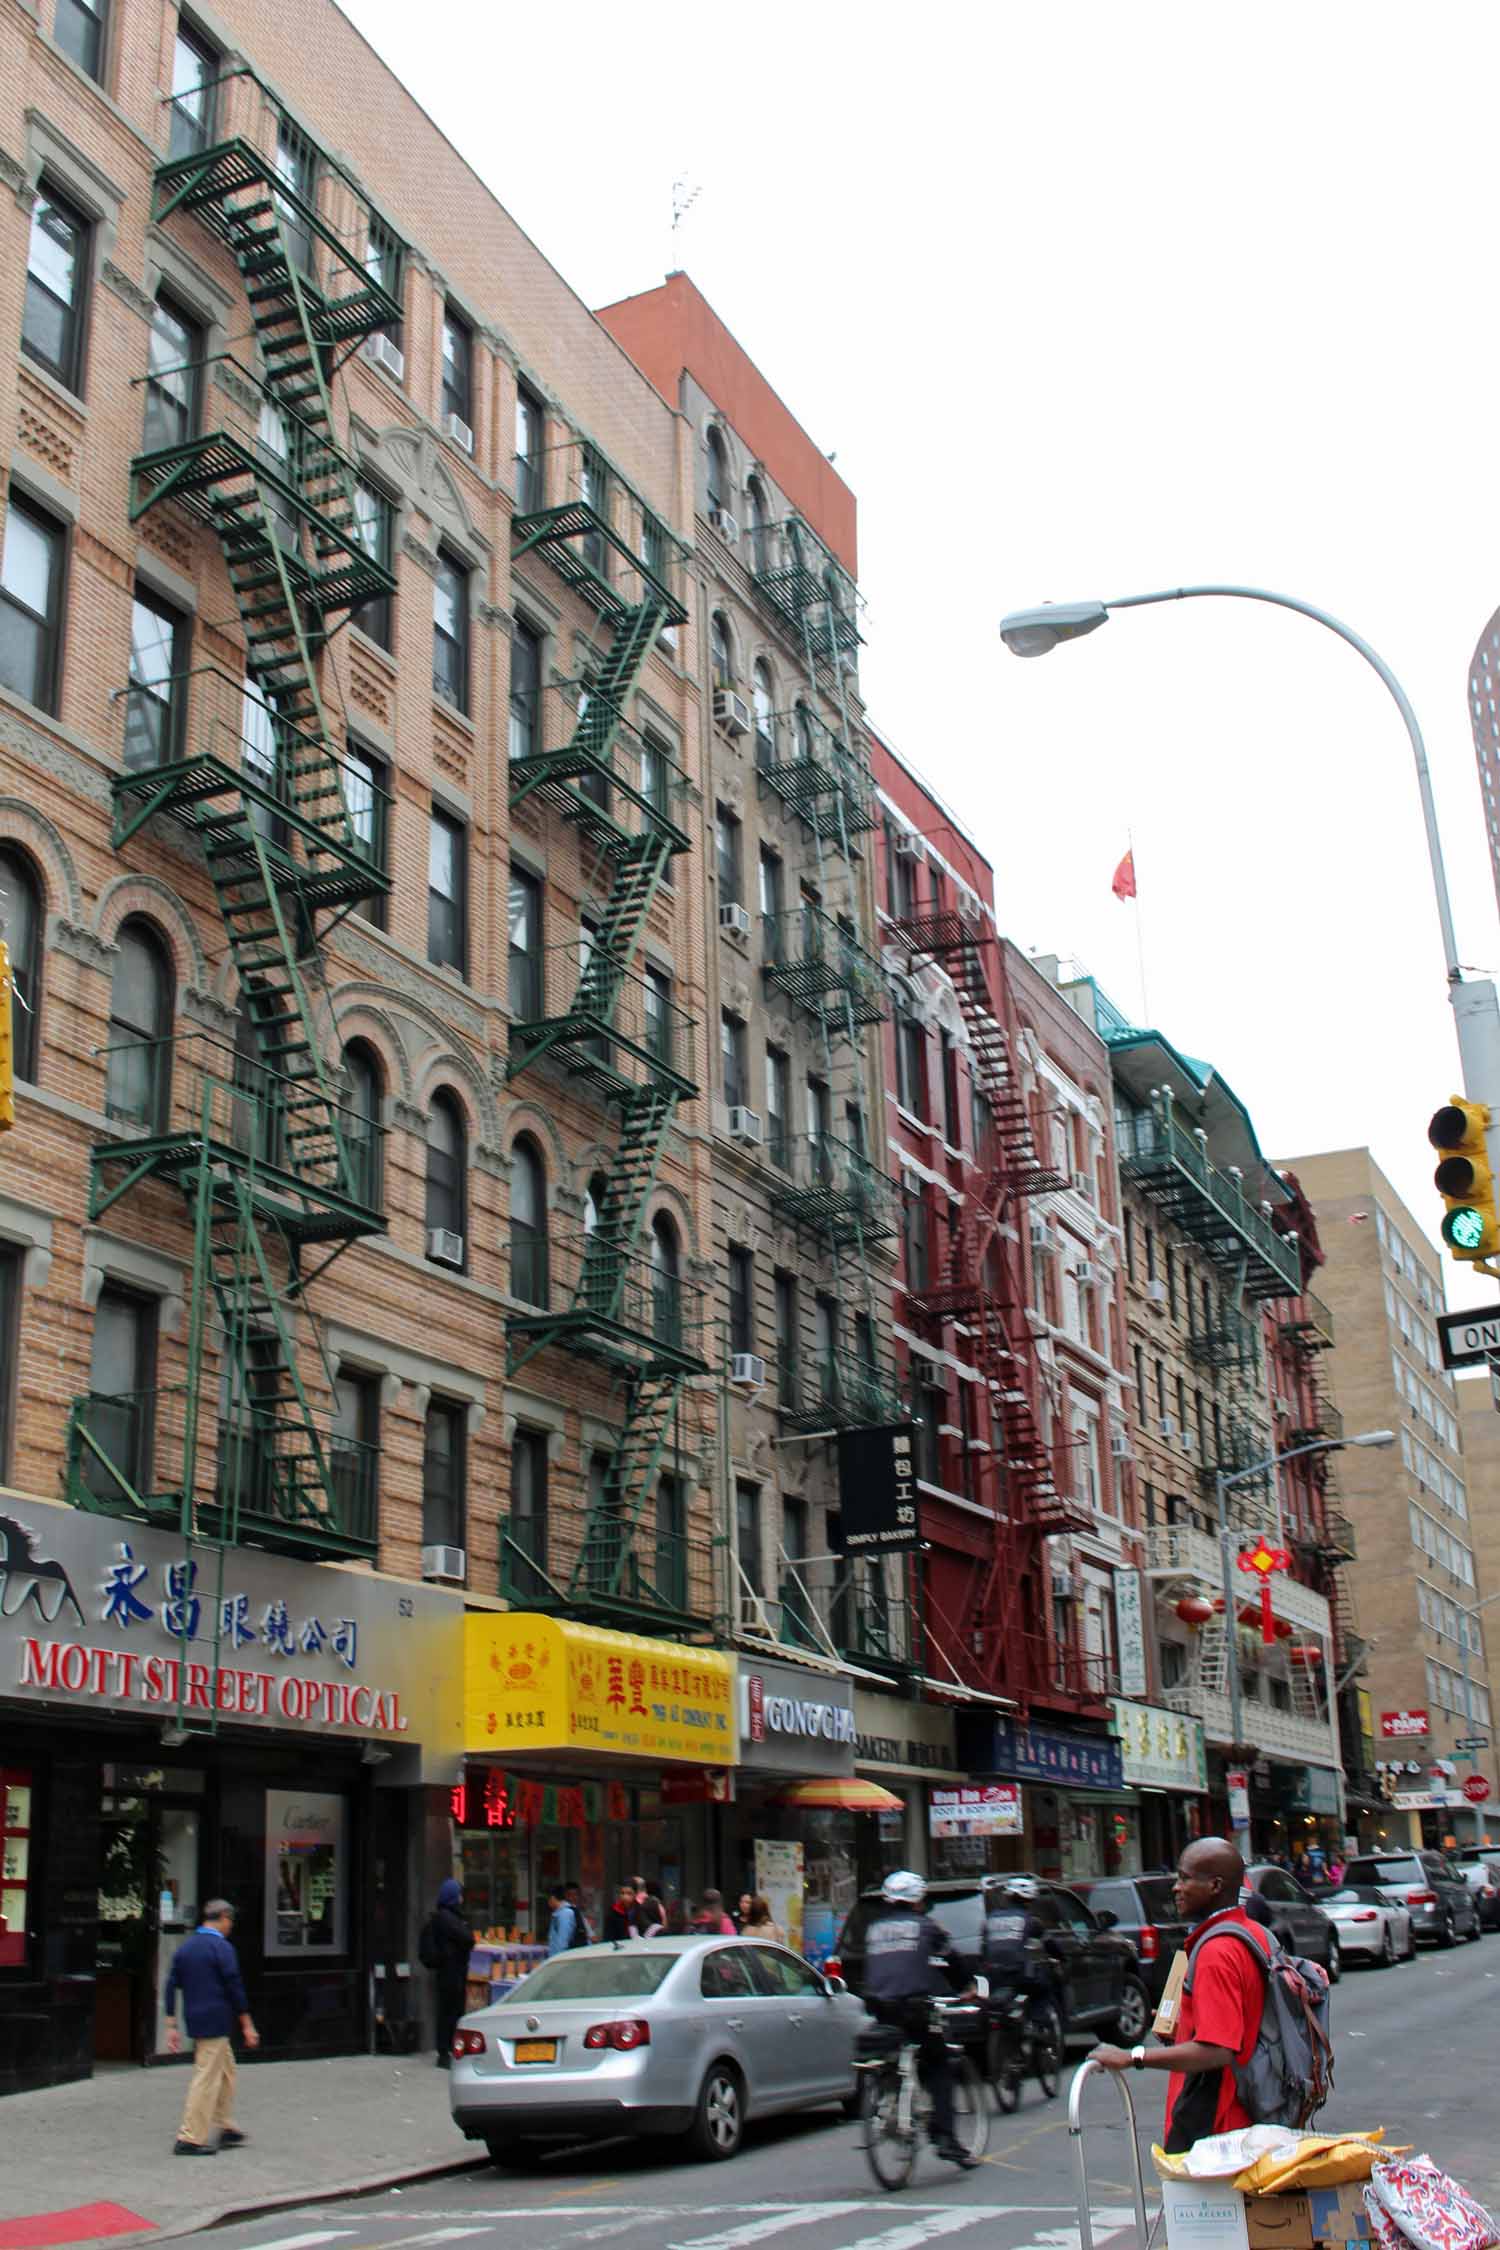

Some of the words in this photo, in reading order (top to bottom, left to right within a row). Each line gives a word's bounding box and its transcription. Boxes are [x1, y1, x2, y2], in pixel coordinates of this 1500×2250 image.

[1464, 1323, 1500, 1348] ON
[847, 1532, 878, 1545] SIMPLY
[880, 1529, 916, 1542] BAKERY
[20, 1637, 139, 1699] MOTT
[142, 1656, 275, 1717] STREET
[279, 1676, 408, 1732] OPTICAL
[767, 1697, 818, 1737] GONG
[821, 1704, 858, 1745] CHA
[1179, 2210, 1195, 2218] ALL
